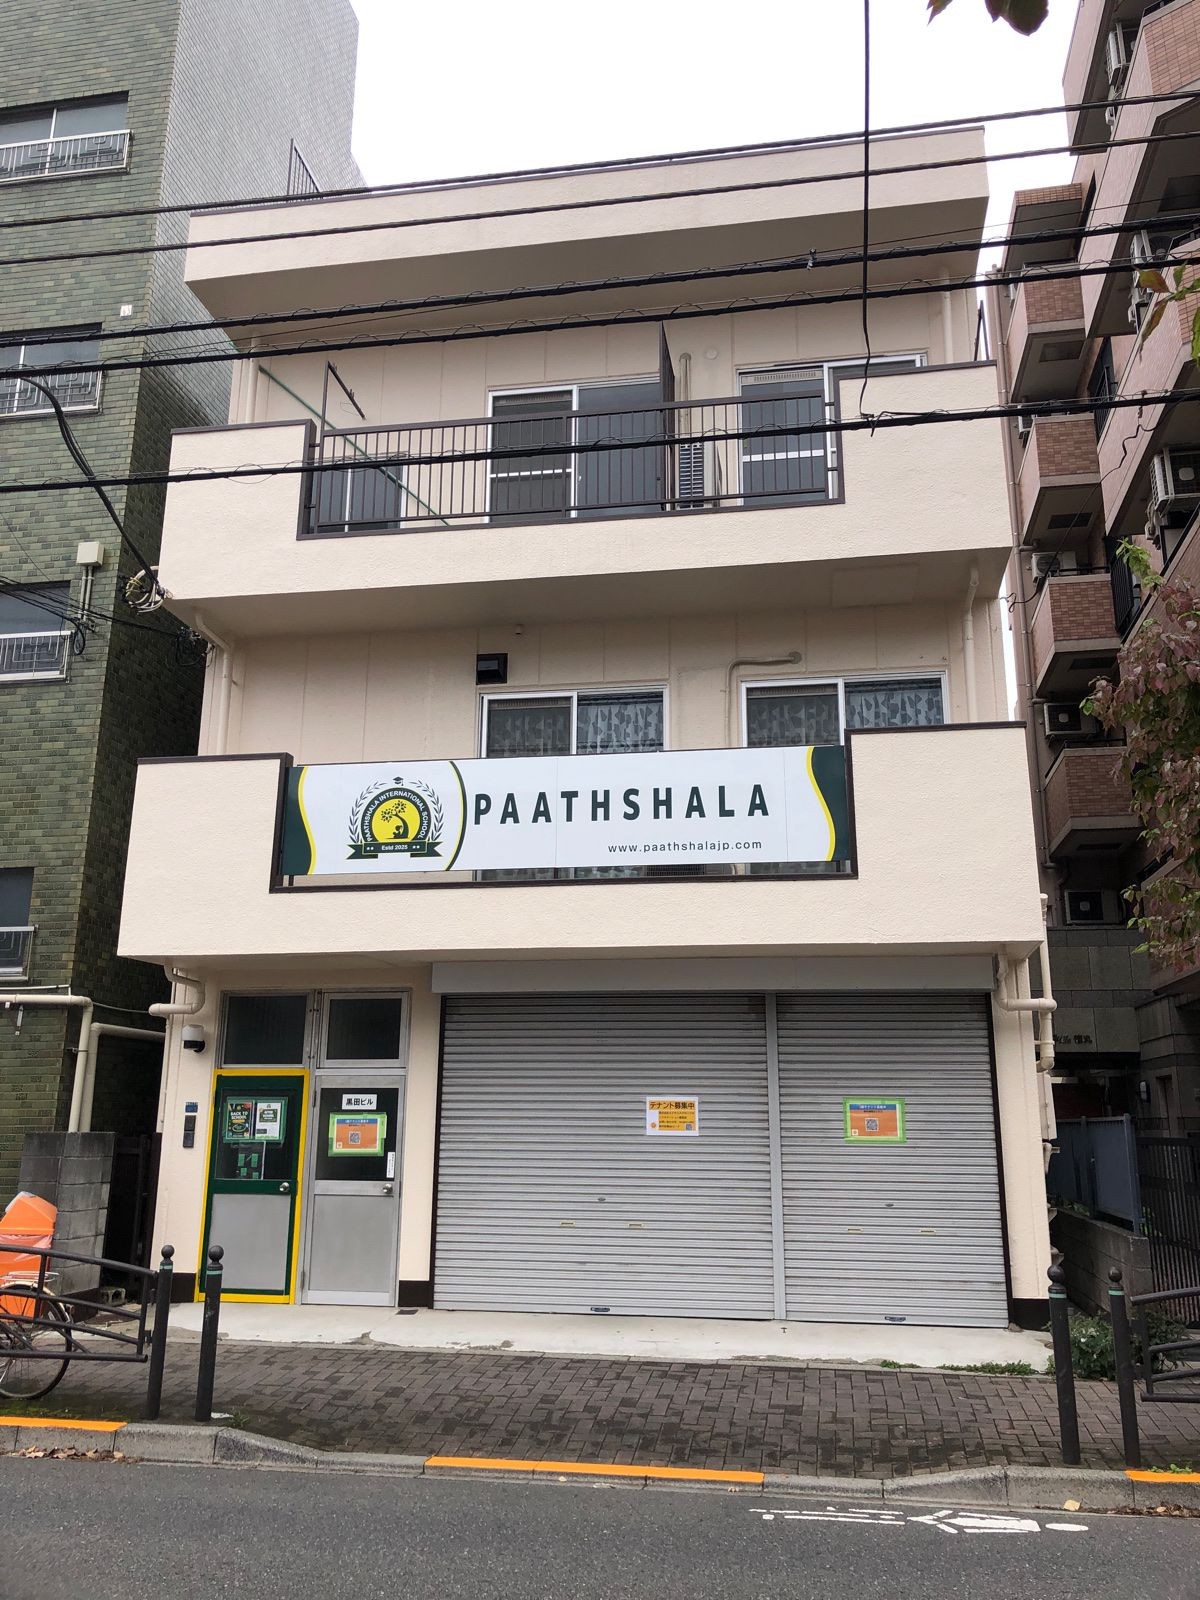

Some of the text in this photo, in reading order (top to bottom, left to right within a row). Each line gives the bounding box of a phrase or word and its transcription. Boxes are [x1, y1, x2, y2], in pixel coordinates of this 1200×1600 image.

[473, 784, 770, 825] PAATHSHALA
[378, 790, 425, 812] INTERNATIONAL
[417, 811, 429, 839] SCHOOL
[607, 840, 763, 853] www.paathshalajp.com
[345, 1097, 374, 1106] 黒田ビル
[650, 1101, 695, 1110] テナント募集中
